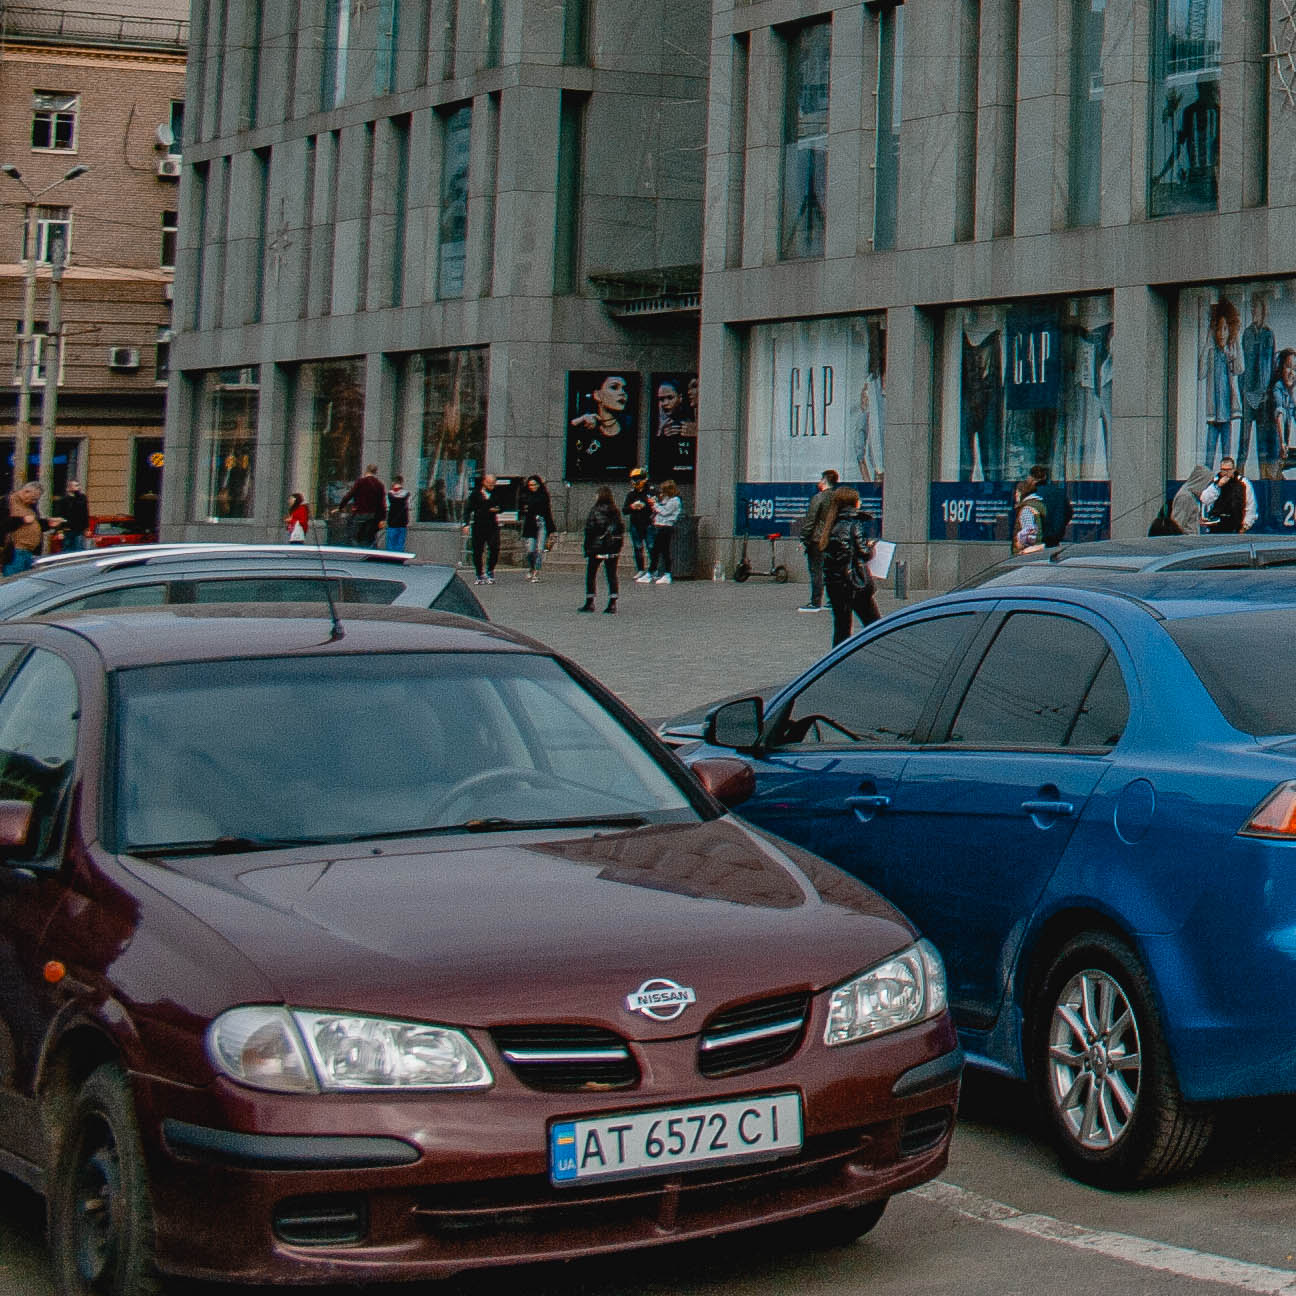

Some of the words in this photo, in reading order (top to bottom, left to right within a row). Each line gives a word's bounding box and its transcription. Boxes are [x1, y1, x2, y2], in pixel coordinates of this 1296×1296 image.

[1013, 331, 1050, 385] GAP
[791, 366, 834, 437] GAP
[942, 499, 974, 523] 1987
[637, 990, 689, 1005] NISSAN
[581, 1124, 633, 1169] AT
[645, 1113, 729, 1159] 6572
[738, 1104, 778, 1145] CI
[558, 1157, 577, 1171] UA
